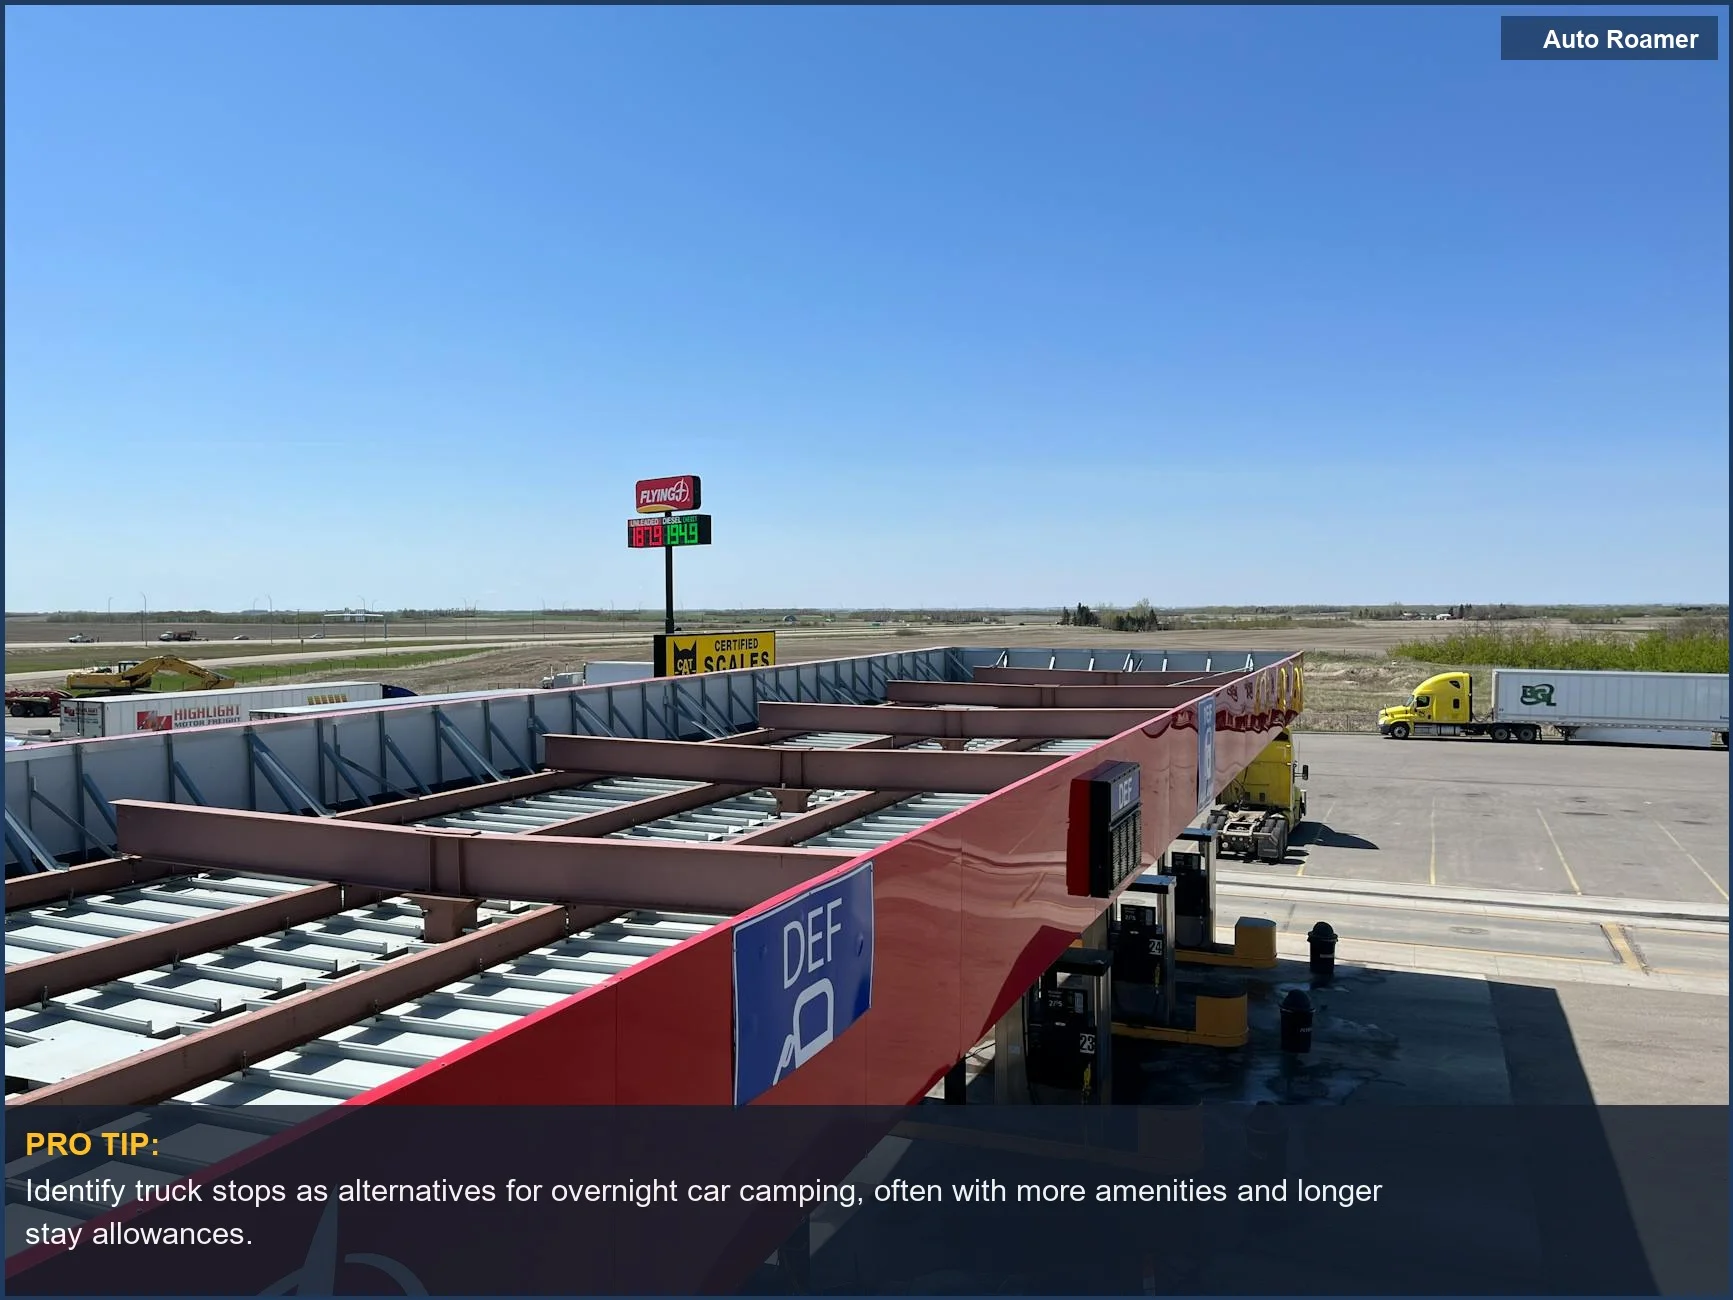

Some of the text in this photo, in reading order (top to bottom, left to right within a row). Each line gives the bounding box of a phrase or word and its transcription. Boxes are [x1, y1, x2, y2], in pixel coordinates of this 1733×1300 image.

[630, 518, 659, 527] UNLEADED
[662, 516, 682, 525] DIESEL
[714, 638, 759, 652] CERTIFIED
[677, 658, 693, 676] CAT
[174, 704, 241, 721] HIGHLIGHT
[174, 717, 241, 728] MOTOR FREIGHT
[1118, 777, 1133, 810] DEF
[783, 898, 843, 990] DEF
[1149, 940, 1162, 953] 24
[1080, 1035, 1096, 1051] 23
